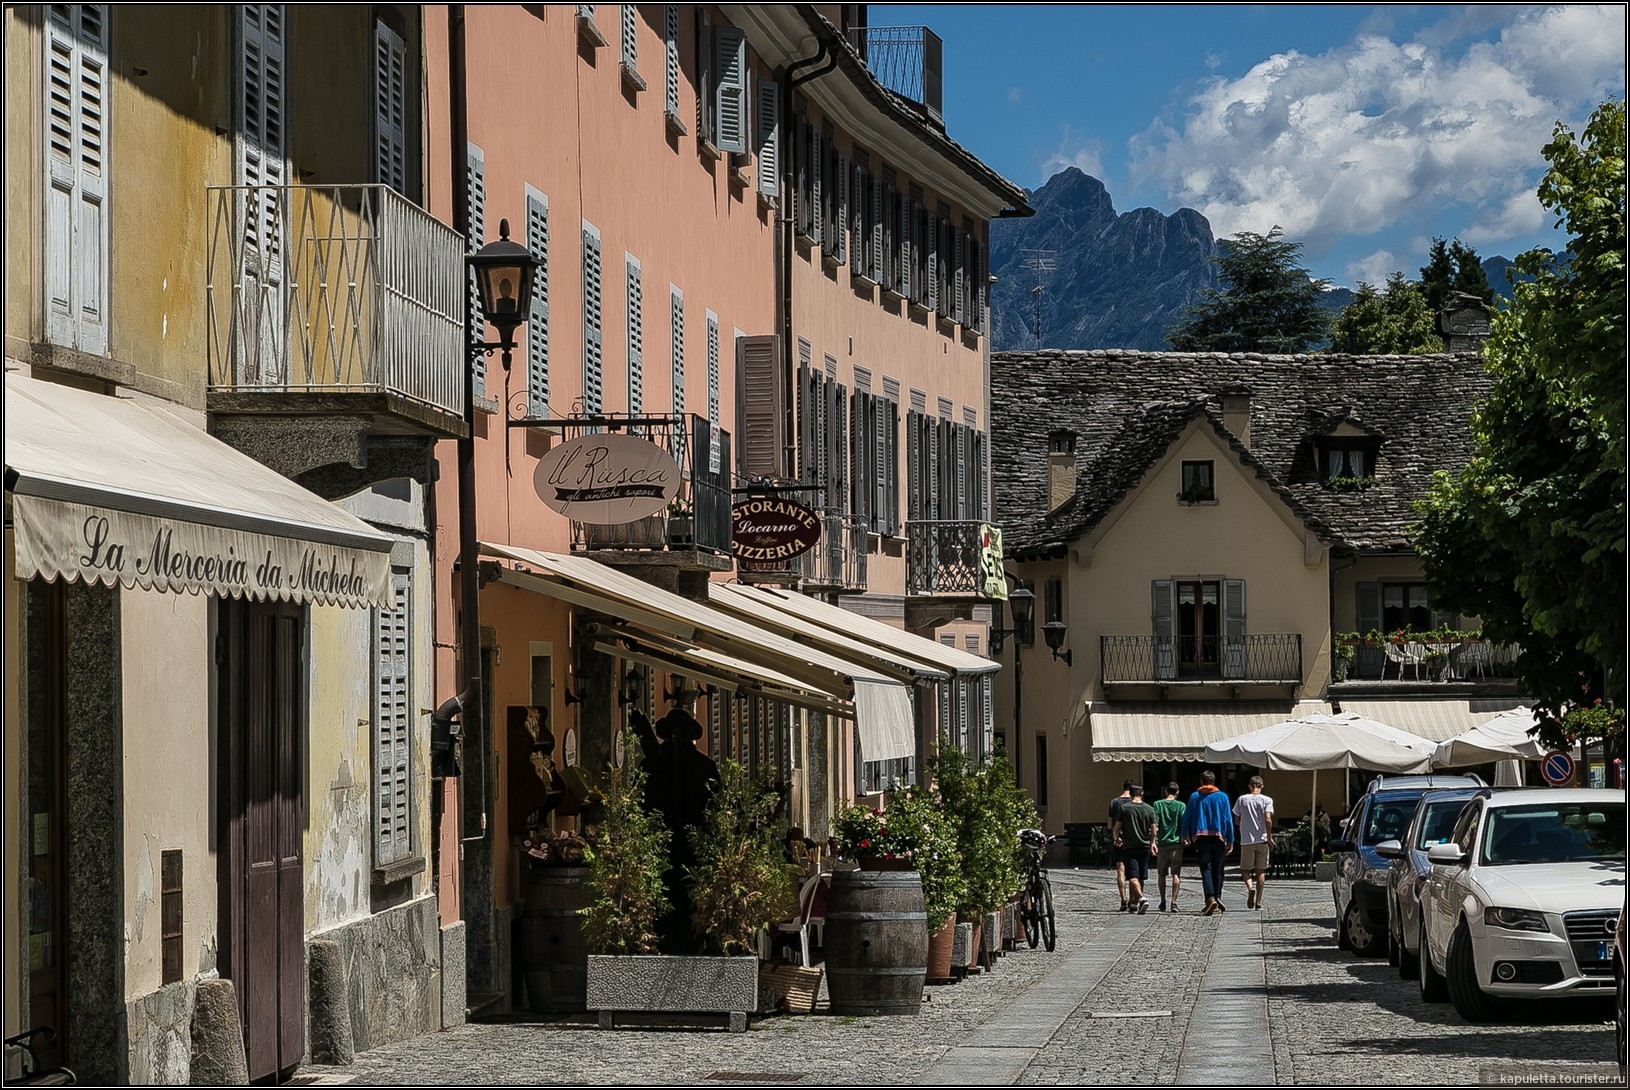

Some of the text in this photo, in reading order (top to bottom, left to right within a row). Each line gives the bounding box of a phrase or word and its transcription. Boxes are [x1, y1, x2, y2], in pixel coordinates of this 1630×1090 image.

[577, 446, 670, 490] Rüsca
[560, 481, 656, 515] gli antichi sapori
[736, 520, 800, 534] Locarno
[79, 515, 365, 597] La Merceria da Michela
